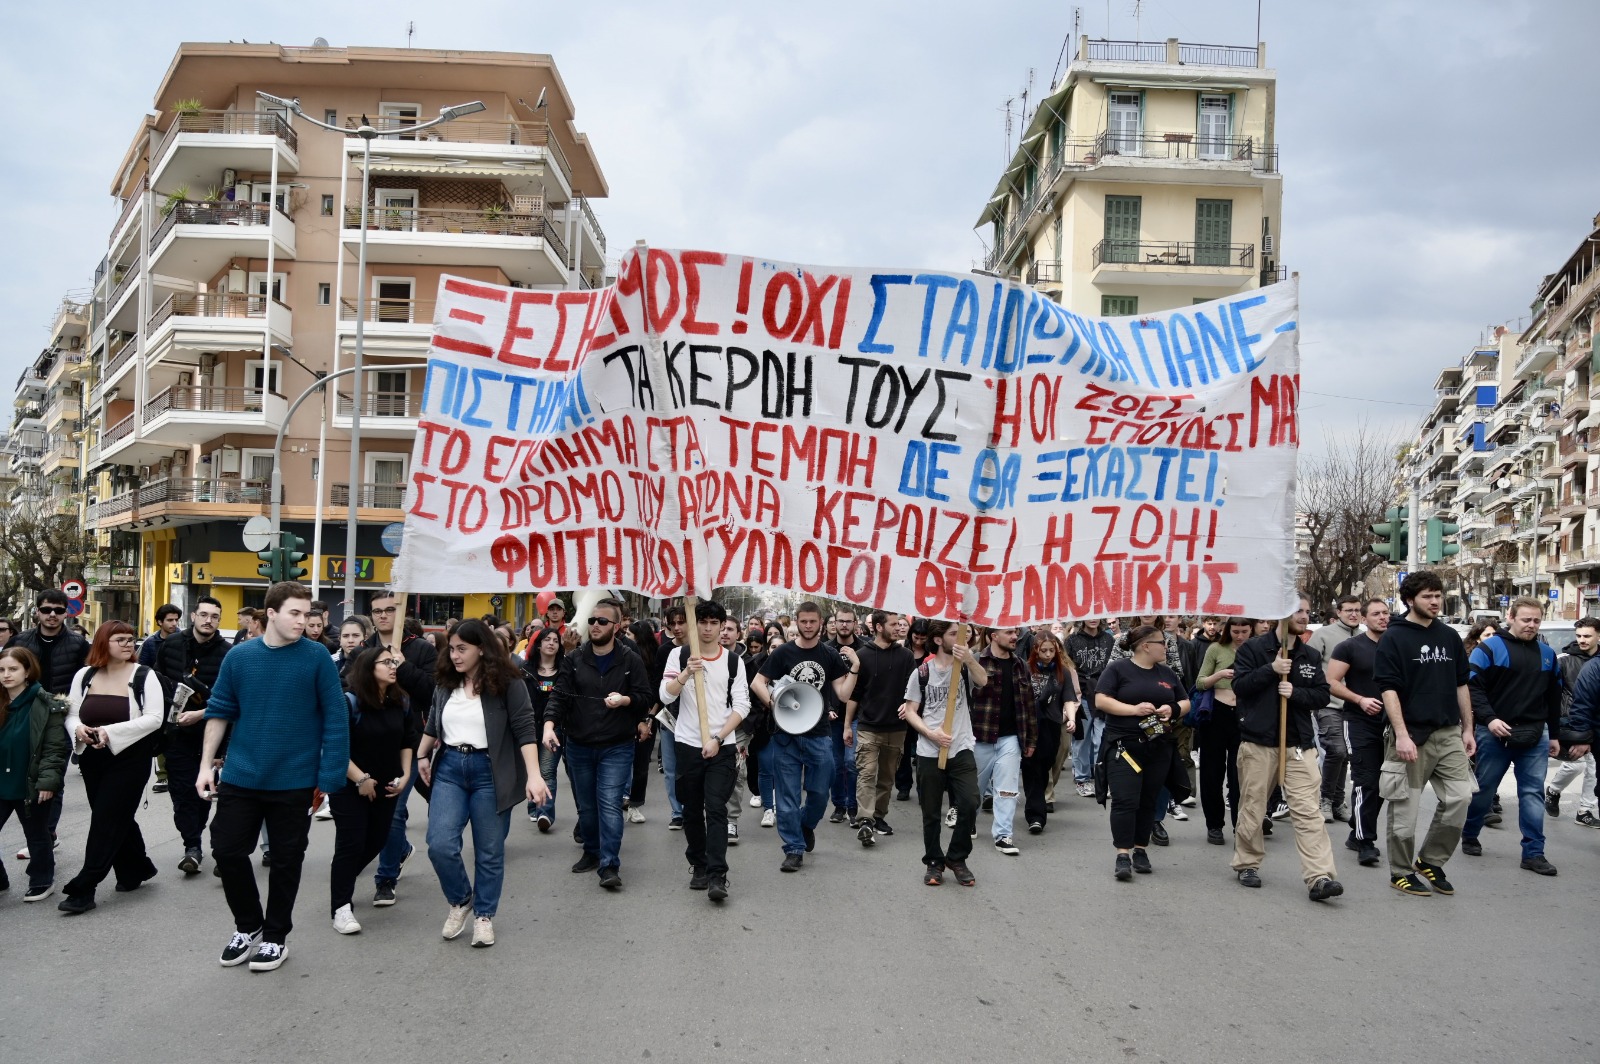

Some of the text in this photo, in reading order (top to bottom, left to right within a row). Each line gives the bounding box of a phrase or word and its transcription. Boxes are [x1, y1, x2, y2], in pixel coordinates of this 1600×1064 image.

[763, 271, 852, 349] ΟΧΙ
[858, 274, 979, 366] ΣΤΑ
[603, 345, 655, 411] ΤΑ
[663, 341, 813, 418] ΚΕΡΔΗ
[838, 354, 972, 442] ΤΟΥΣ
[1030, 373, 1063, 443] ΟΙ
[1085, 413, 1244, 452] ΣΠΟΥΔΕΣ
[418, 420, 471, 475] ΤΟ
[483, 414, 638, 483] ΕΓΚΛΗΜΑ
[720, 415, 877, 488] ΤΕΜΠΗ
[898, 440, 962, 502] ΔΕ
[969, 449, 1022, 510] ΘΑ
[410, 472, 488, 534] ΣΤΟ
[500, 469, 625, 530] ΔΡΟΜΟ
[628, 470, 665, 531] ΤΟΥ
[813, 485, 1017, 573] ΚΕΡΔΙΖΕΙ
[1042, 512, 1073, 566] Η
[490, 527, 695, 597] ΦΟΙΤΗΤΙΚΟΙ
[914, 560, 1245, 628] ΘΕΣΣΑΛΟΝΙΚΗΣ
